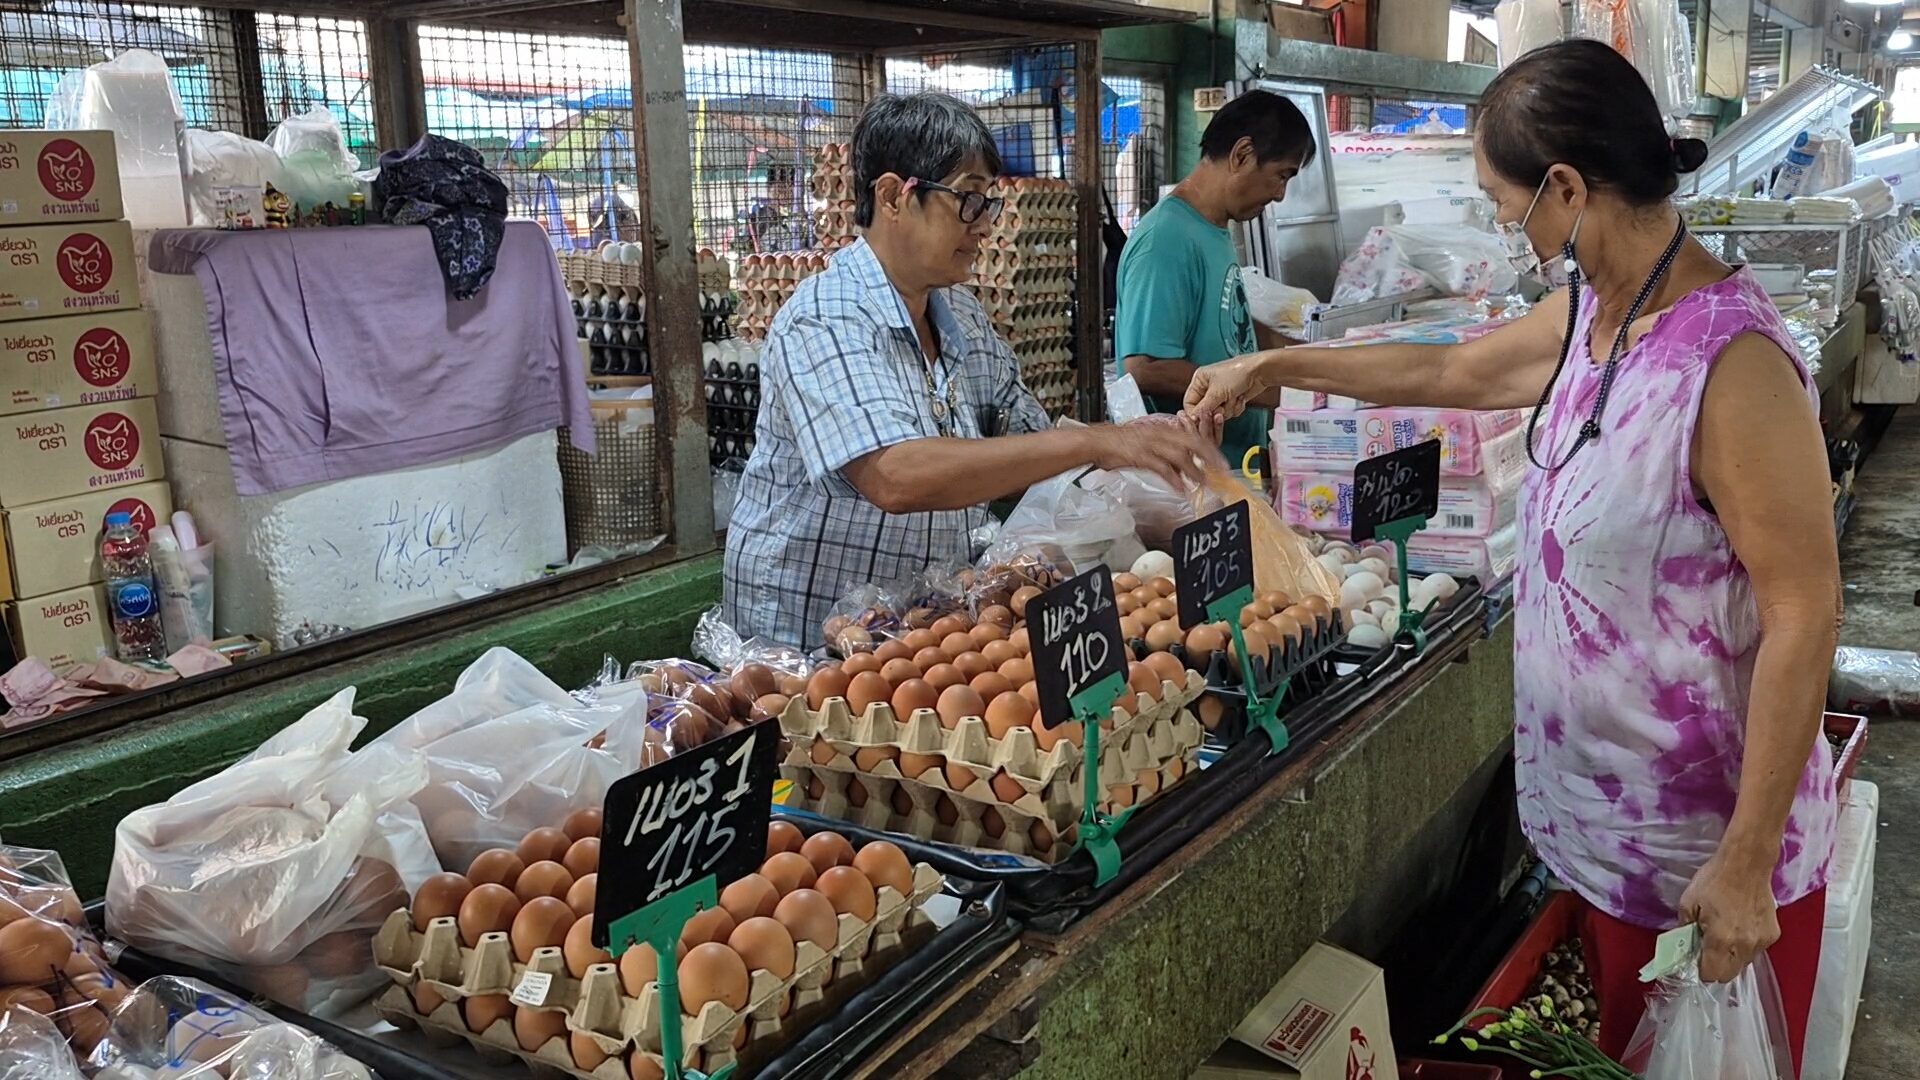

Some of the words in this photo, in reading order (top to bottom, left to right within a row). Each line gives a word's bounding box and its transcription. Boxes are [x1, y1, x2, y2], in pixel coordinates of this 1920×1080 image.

[55, 181, 84, 193] SNS
[10, 252, 39, 266] ตรา
[75, 272, 103, 285] SNS
[27, 348, 56, 363] ตรา
[91, 366, 120, 380] SNS
[38, 436, 67, 451] ตรา
[102, 449, 130, 464] SNS
[58, 523, 85, 538] ตรา
[1225, 511, 1239, 541] 3
[1200, 549, 1241, 602] 105
[63, 612, 92, 628] ตรา
[1060, 630, 1109, 699] 110
[722, 729, 757, 803] 1
[646, 801, 740, 902] 115
